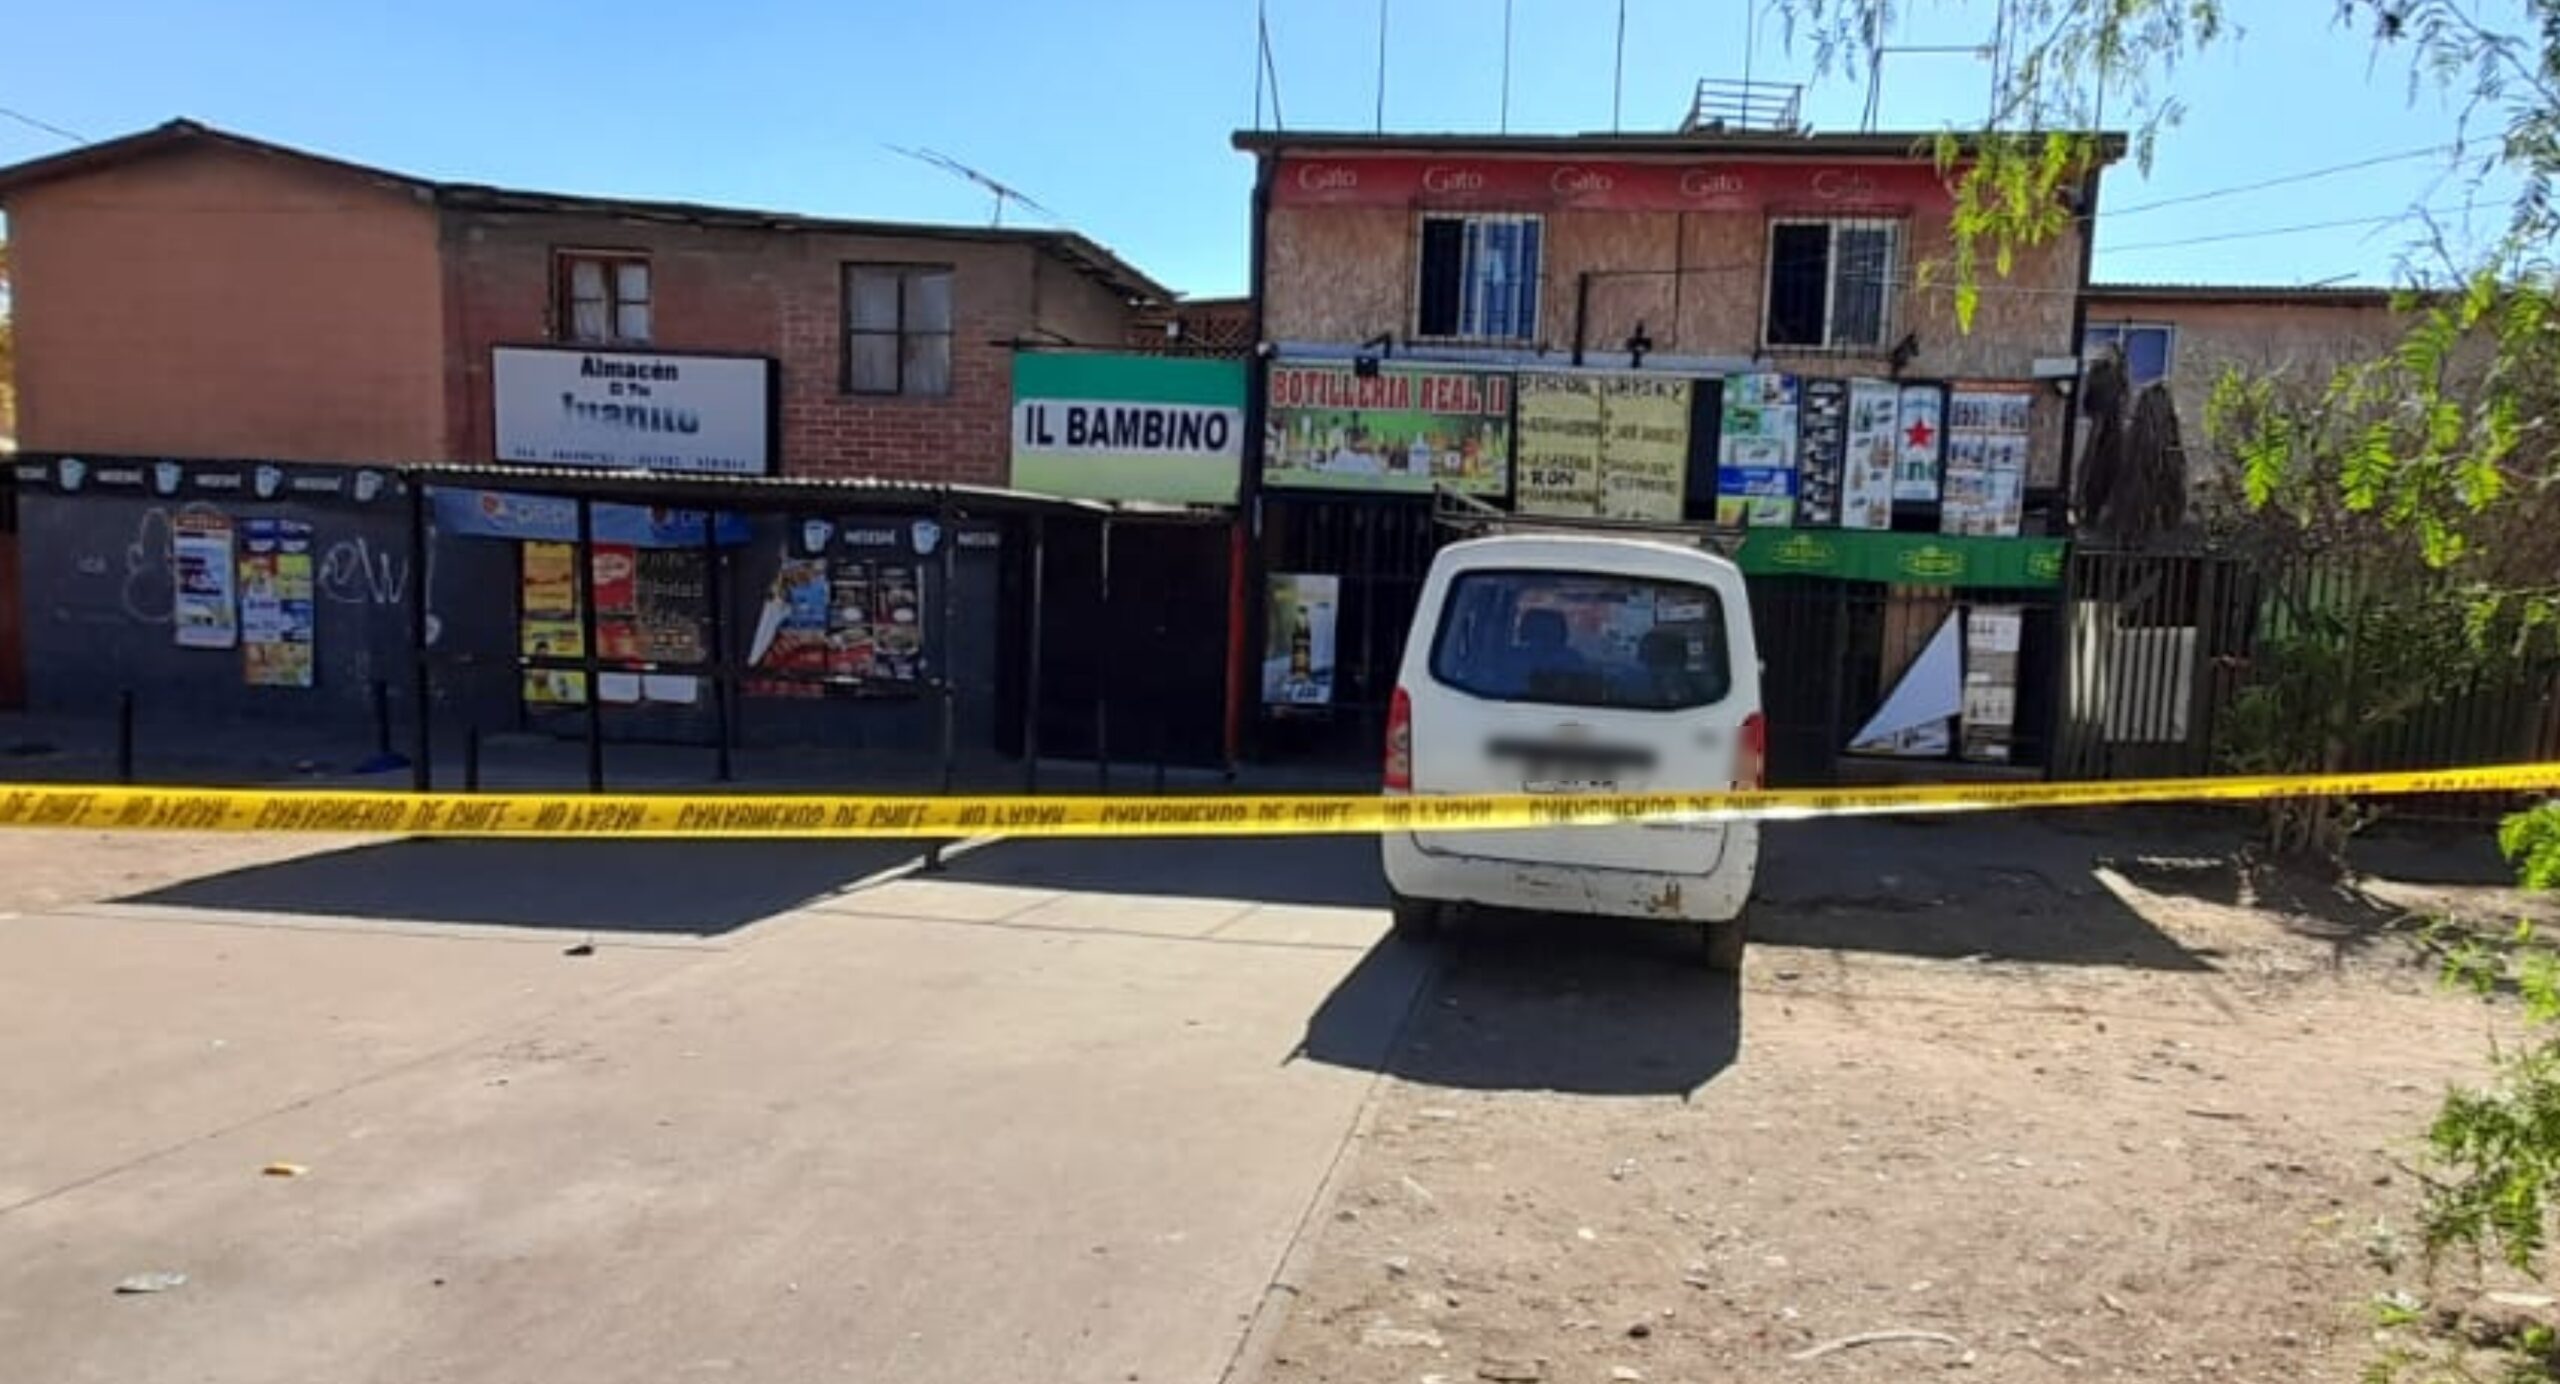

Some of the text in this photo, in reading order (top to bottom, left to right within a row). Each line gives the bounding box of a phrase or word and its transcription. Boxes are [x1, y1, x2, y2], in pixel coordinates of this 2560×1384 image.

[1298, 163, 1358, 190] Gato
[1422, 165, 1482, 192] Gato
[1547, 166, 1614, 195] Gato
[1680, 168, 1743, 197] Gato
[581, 355, 680, 381] Almacén
[1271, 369, 1508, 415] BOTILLERIA REAL II
[1026, 405, 1229, 451] IL BAMBINO
[1530, 470, 1576, 487] RON
